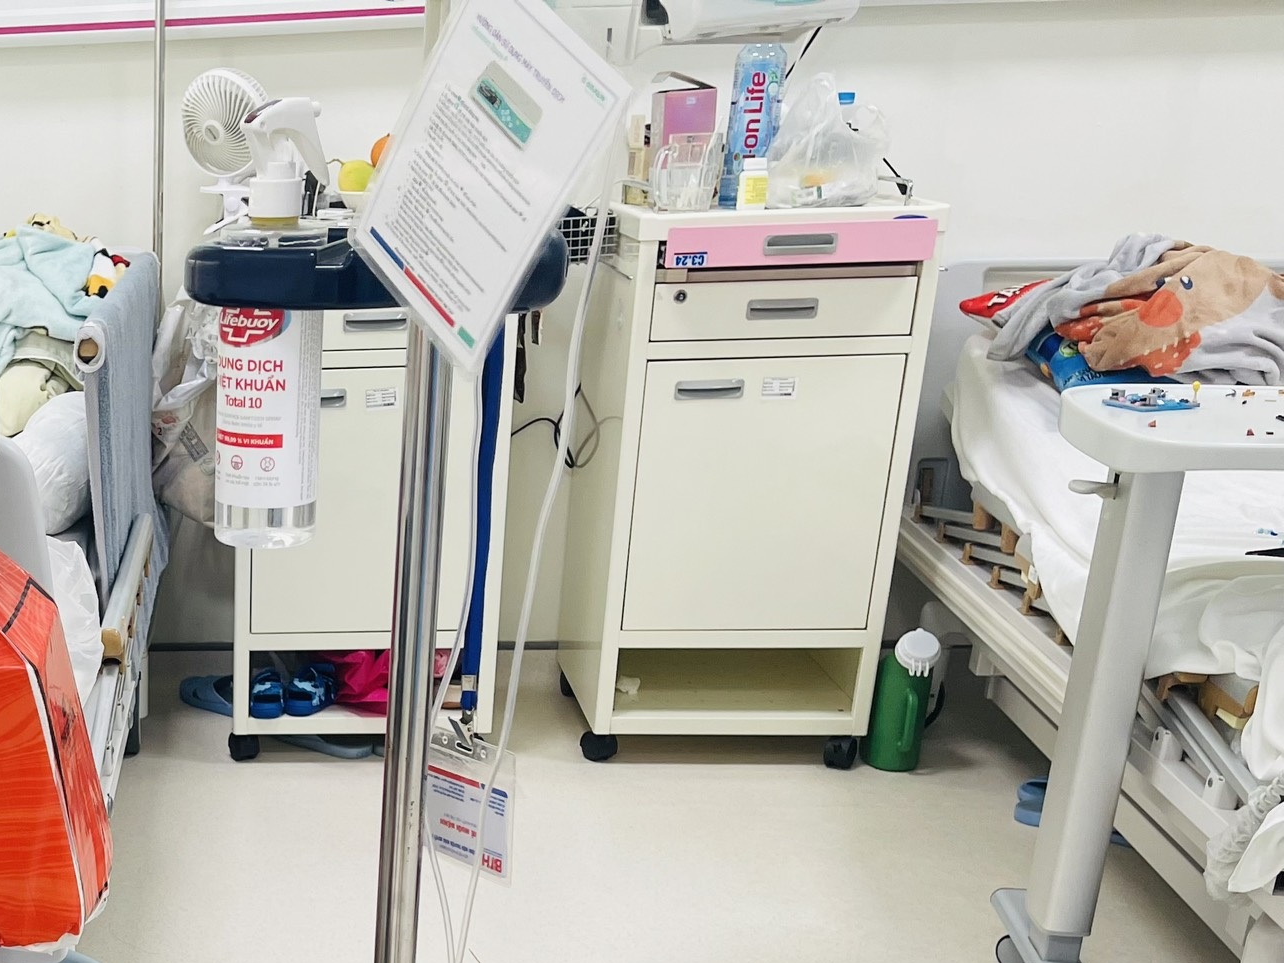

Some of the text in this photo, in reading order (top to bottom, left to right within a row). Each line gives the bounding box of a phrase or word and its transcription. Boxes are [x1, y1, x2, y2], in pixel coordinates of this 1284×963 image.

[743, 71, 766, 114] Life
[674, 254, 705, 266] C3.24
[219, 311, 281, 331] Lifebuoy
[247, 360, 284, 375] DỊCH
[235, 375, 286, 392] KHUẨN
[225, 394, 263, 409] Total 10
